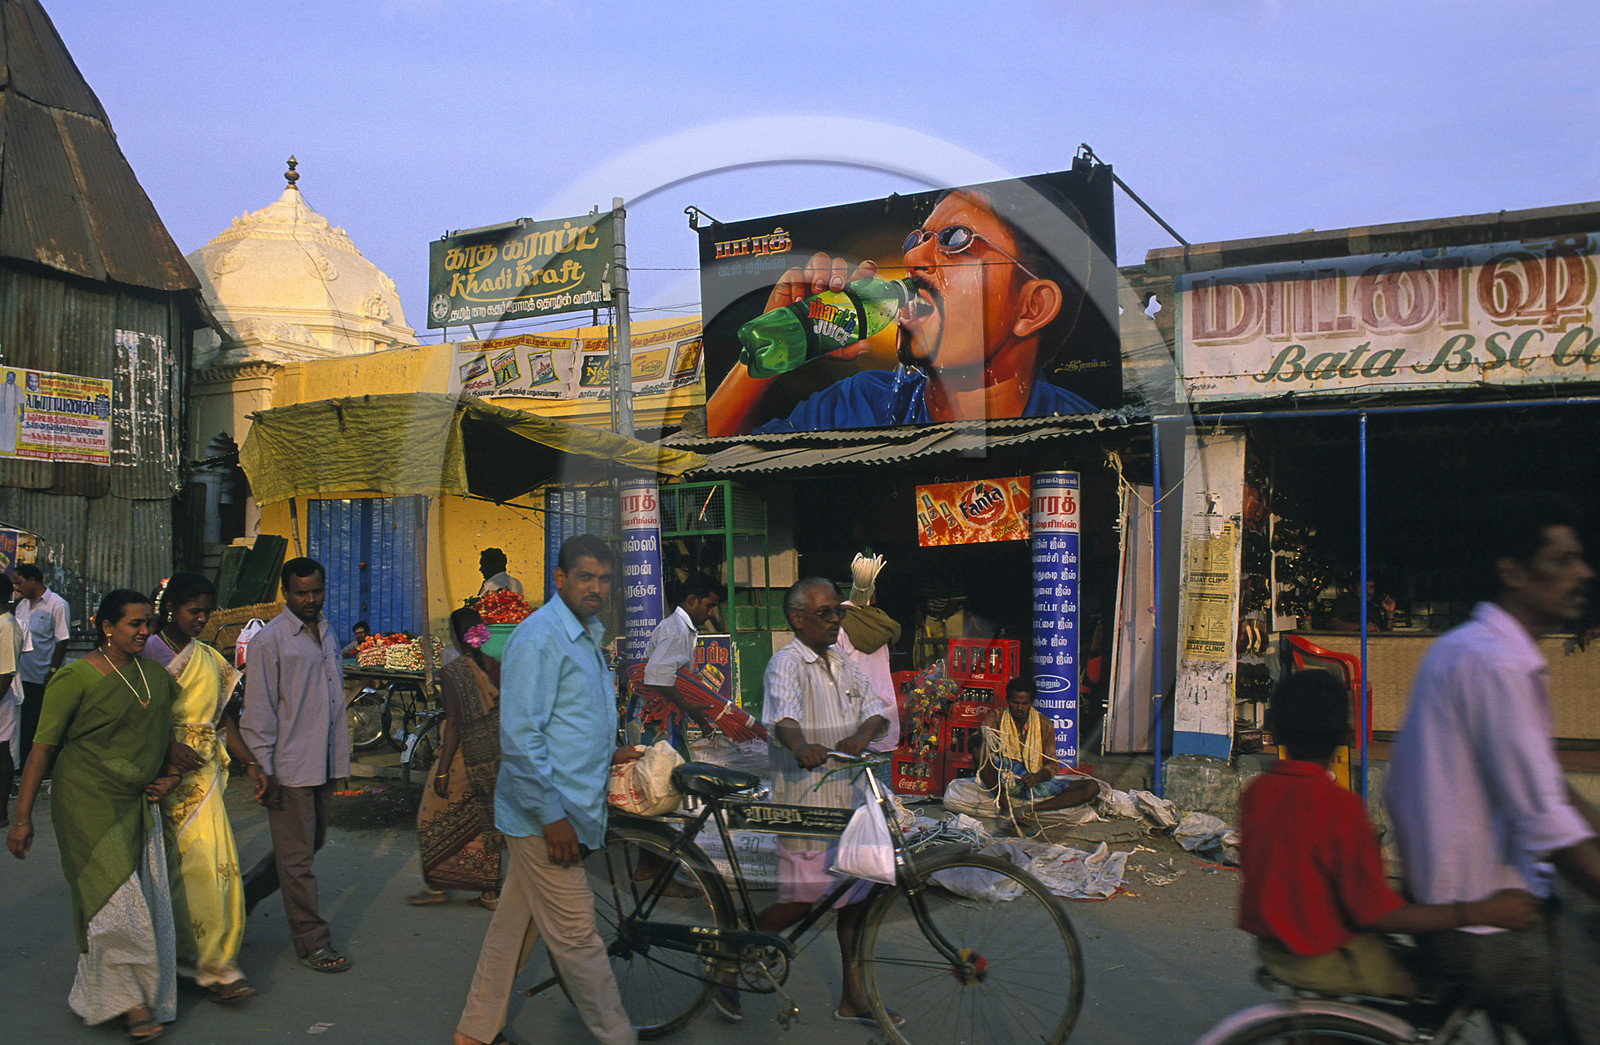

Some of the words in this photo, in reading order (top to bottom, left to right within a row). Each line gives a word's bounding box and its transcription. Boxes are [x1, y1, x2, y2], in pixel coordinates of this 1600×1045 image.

[714, 227, 792, 260] பாரத்
[449, 268, 512, 298] Khadi
[515, 259, 586, 288] Kraft
[573, 290, 603, 305] வாரிய
[808, 298, 857, 334] Bharath
[814, 320, 852, 346] JUICE
[1252, 340, 1406, 384] Bata
[1411, 328, 1544, 374] BSC
[620, 488, 656, 513] ாரத்
[958, 487, 1004, 520] Fanta
[622, 516, 658, 526] டிரிங்ஸ்
[1033, 519, 1077, 530] ல்டிரிங்ஸ்
[624, 581, 657, 600] ரஞ்சு
[626, 618, 656, 628] வையான
[707, 640, 728, 666] பீடி
